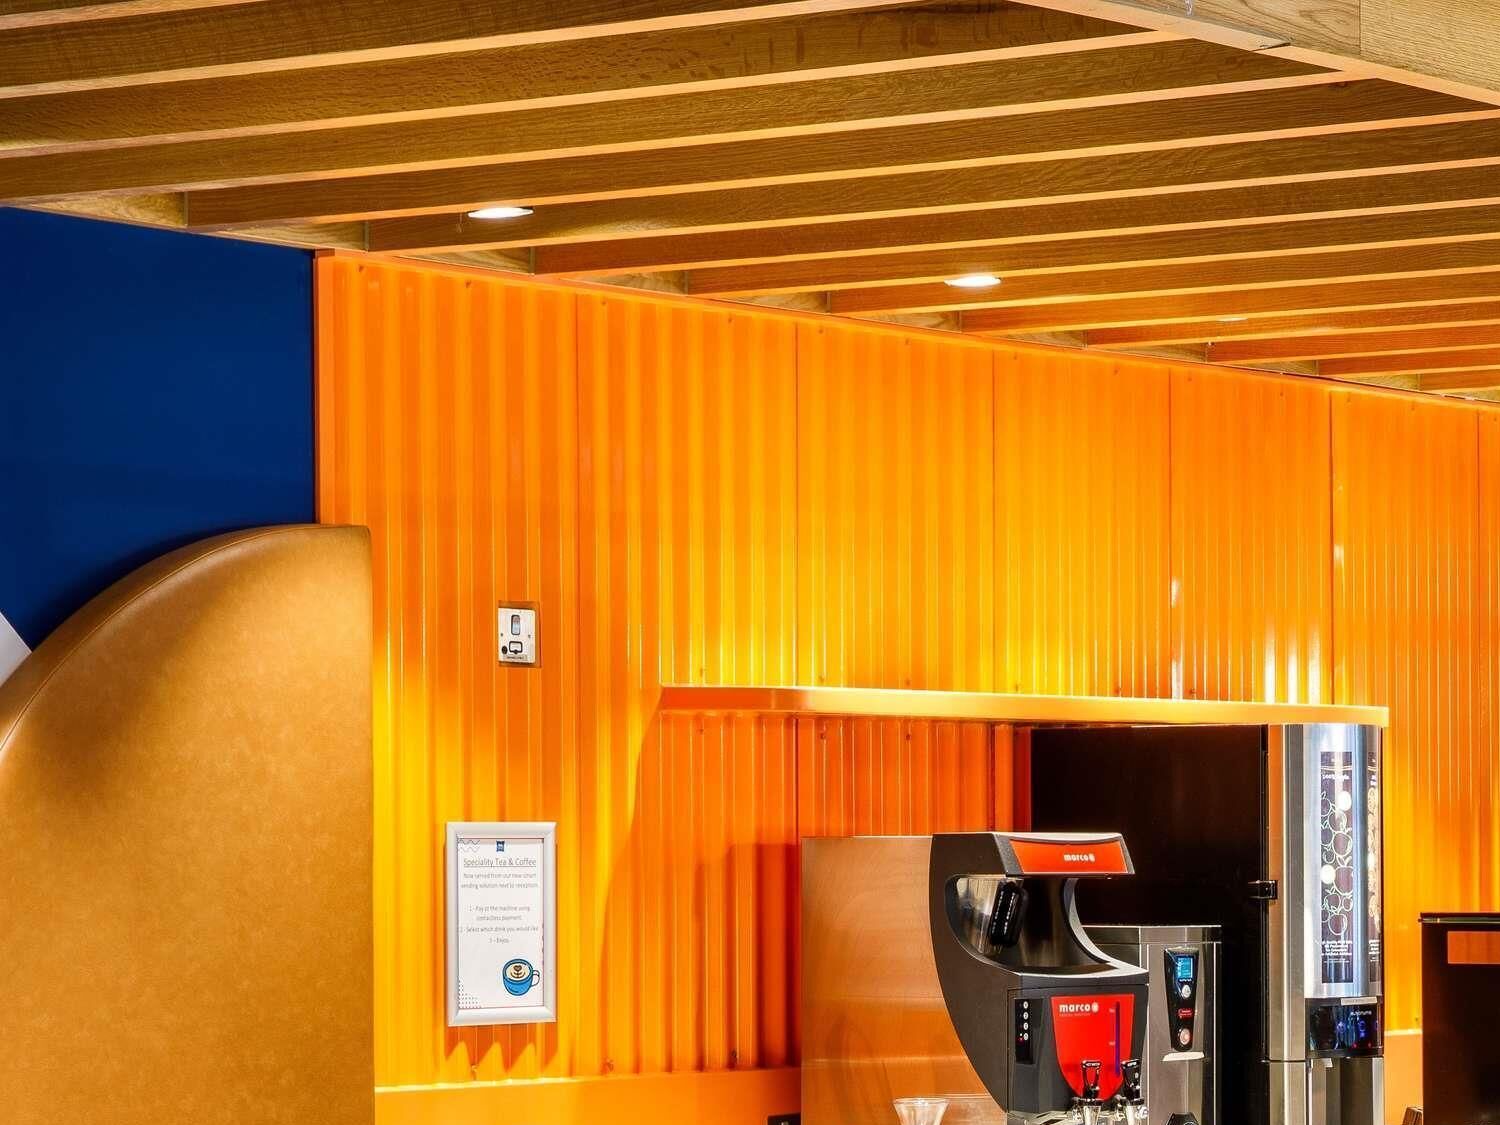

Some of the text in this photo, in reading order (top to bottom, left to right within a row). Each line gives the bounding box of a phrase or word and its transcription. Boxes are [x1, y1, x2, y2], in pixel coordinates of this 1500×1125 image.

[1063, 854, 1089, 862] marco
[464, 857, 537, 868] Speciality Tea & Coffee
[1059, 1004, 1090, 1012] marco
